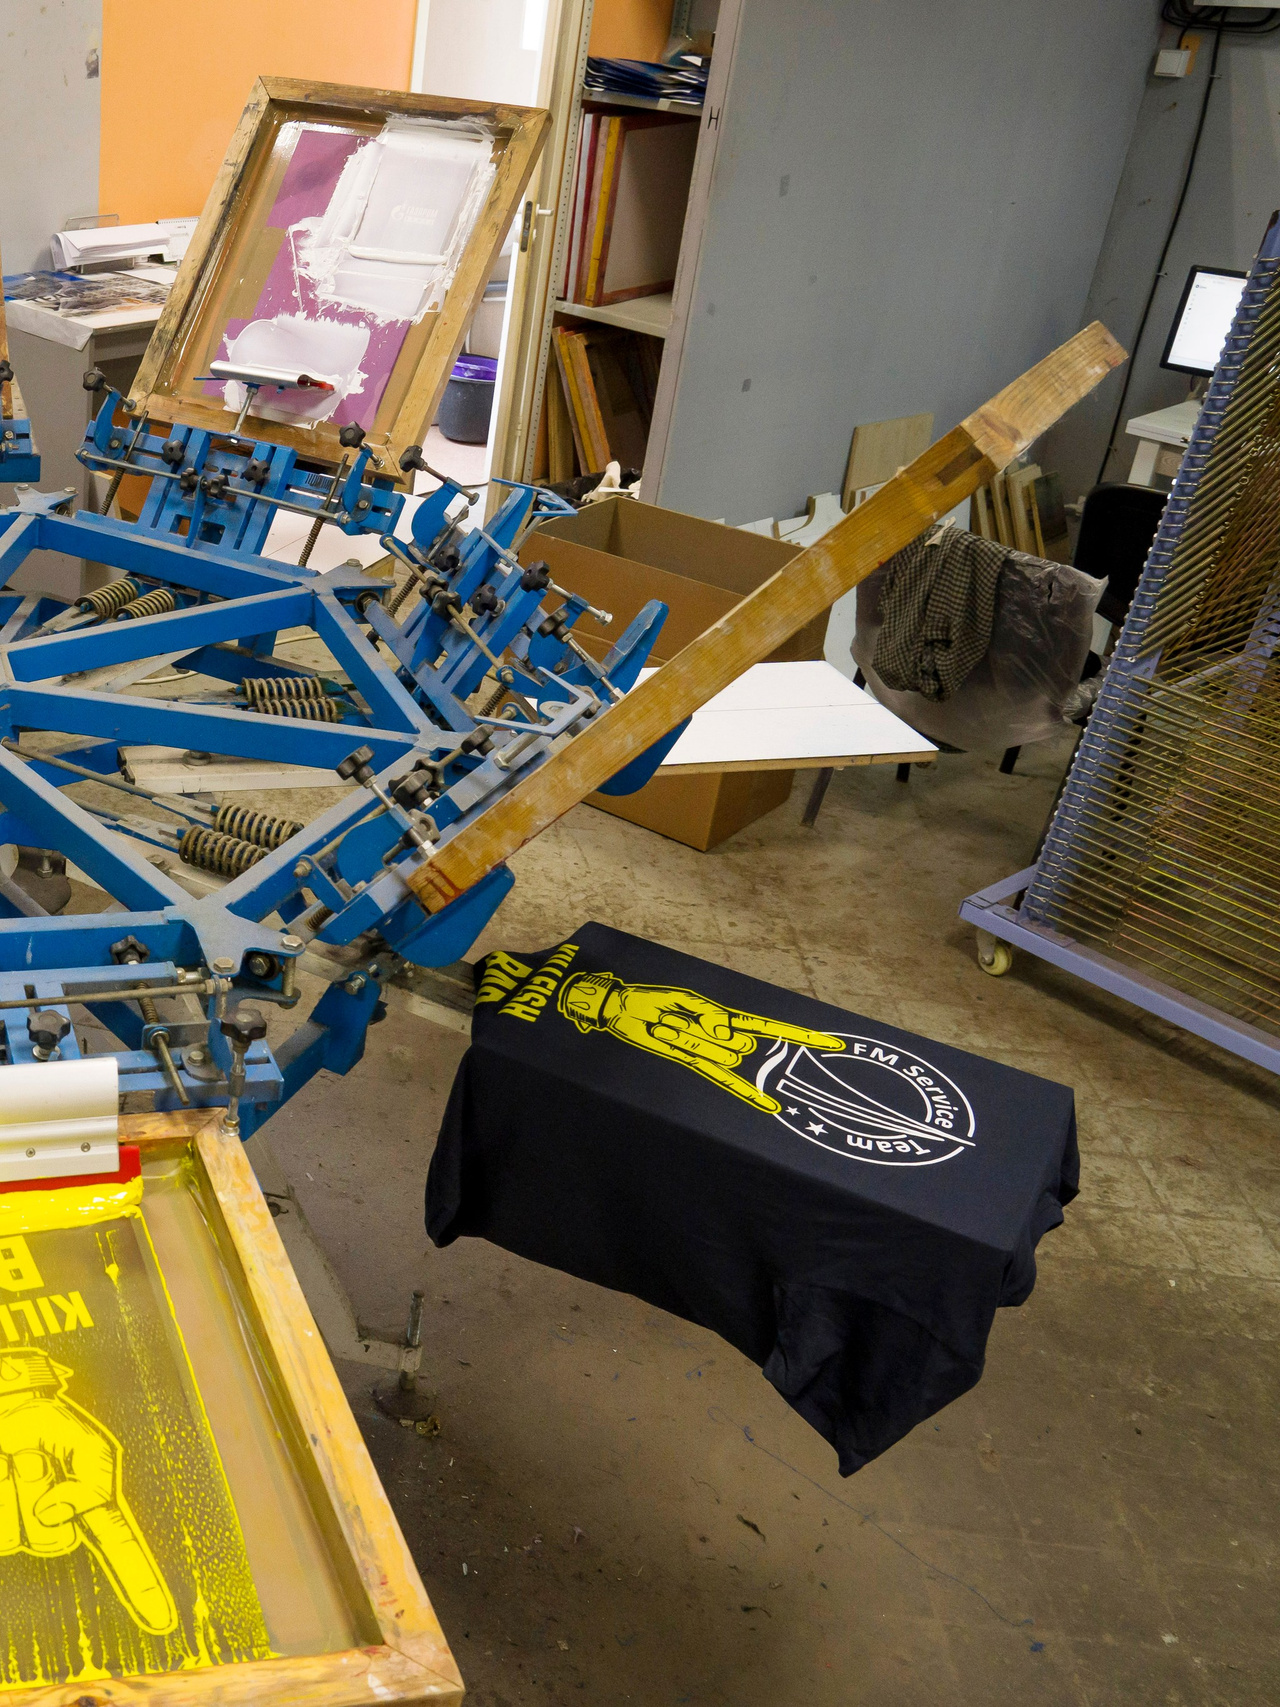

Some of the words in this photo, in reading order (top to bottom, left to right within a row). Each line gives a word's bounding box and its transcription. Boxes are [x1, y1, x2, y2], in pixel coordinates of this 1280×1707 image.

[498, 944, 579, 1022] KILLFISH
[853, 1043, 899, 1066] FM
[902, 1065, 959, 1129] Service
[846, 1134, 931, 1155] Team
